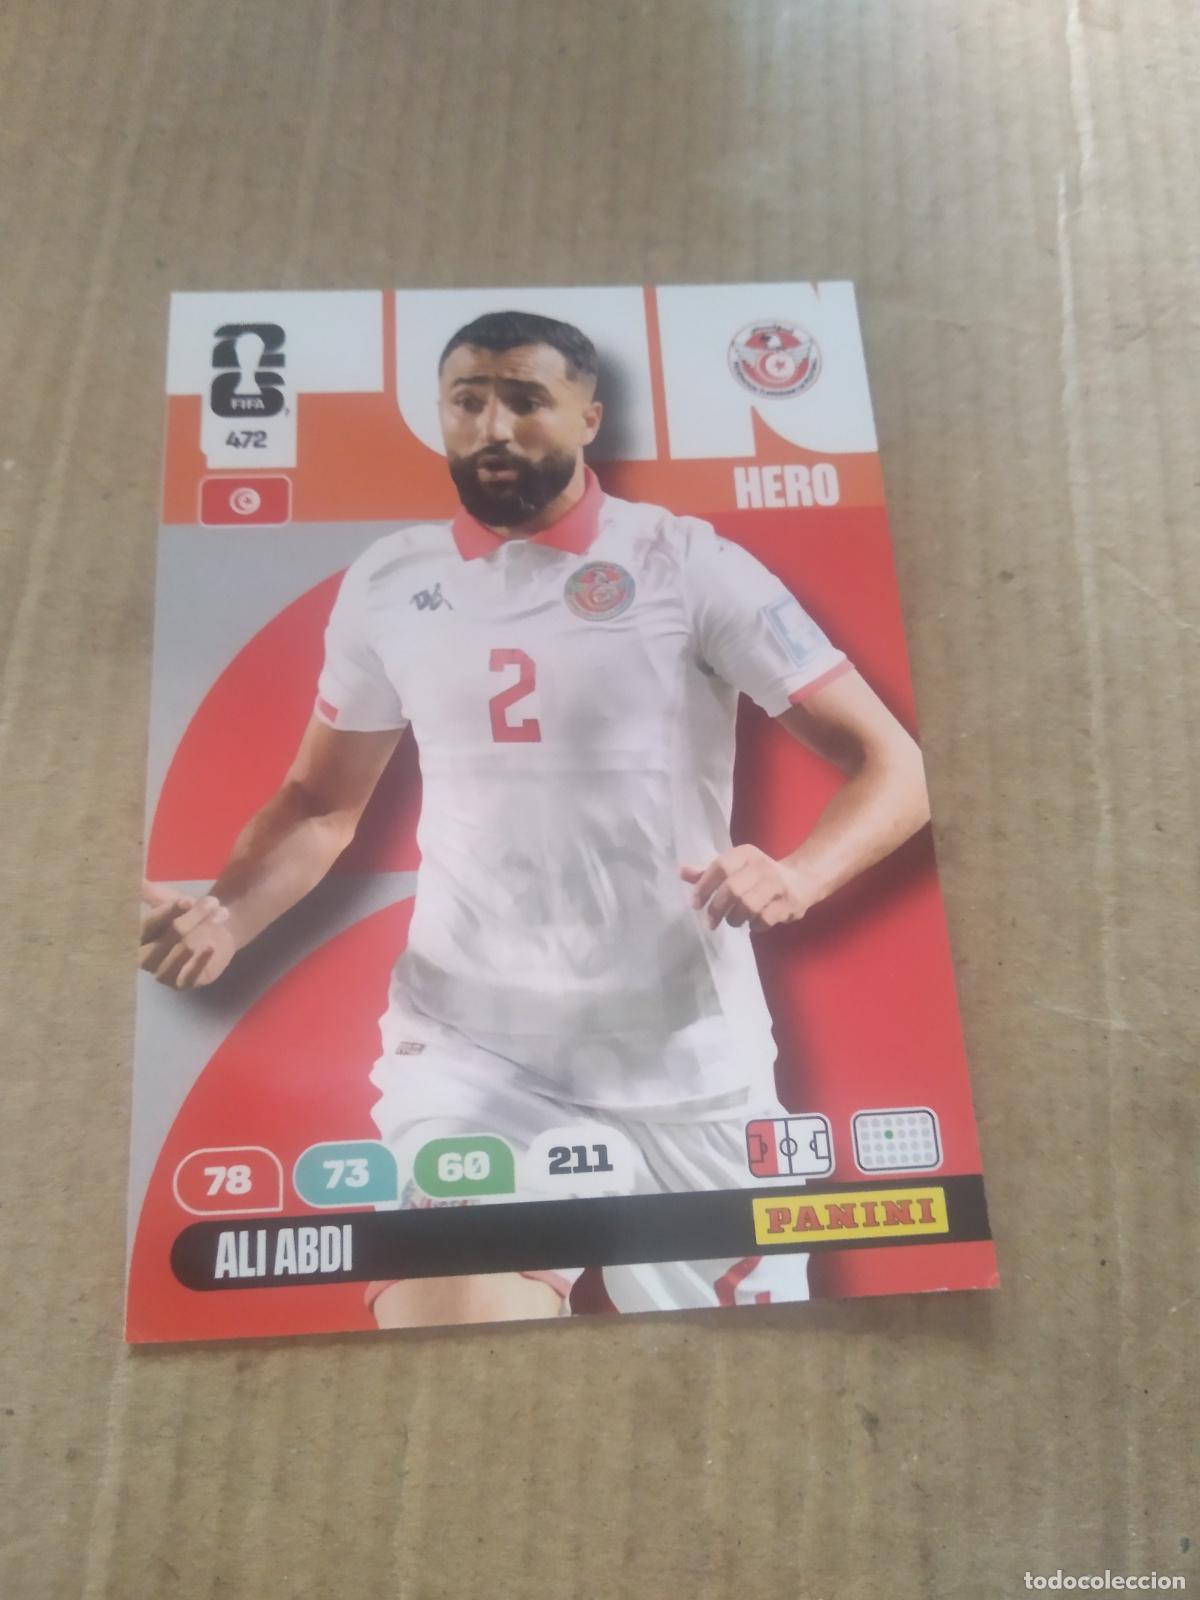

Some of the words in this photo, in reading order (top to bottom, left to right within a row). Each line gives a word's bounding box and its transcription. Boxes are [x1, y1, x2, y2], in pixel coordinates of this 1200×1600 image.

[231, 397, 265, 410] FIFA
[226, 430, 267, 448] 472
[733, 463, 840, 509] HERO
[489, 648, 542, 742] 2
[323, 1159, 370, 1189] 73
[437, 1151, 490, 1182] 60
[548, 1145, 613, 1175] 211
[205, 1166, 252, 1196] 78
[765, 1198, 937, 1234] PANINI
[215, 1230, 266, 1279] ALI
[274, 1225, 353, 1276] ABDI
